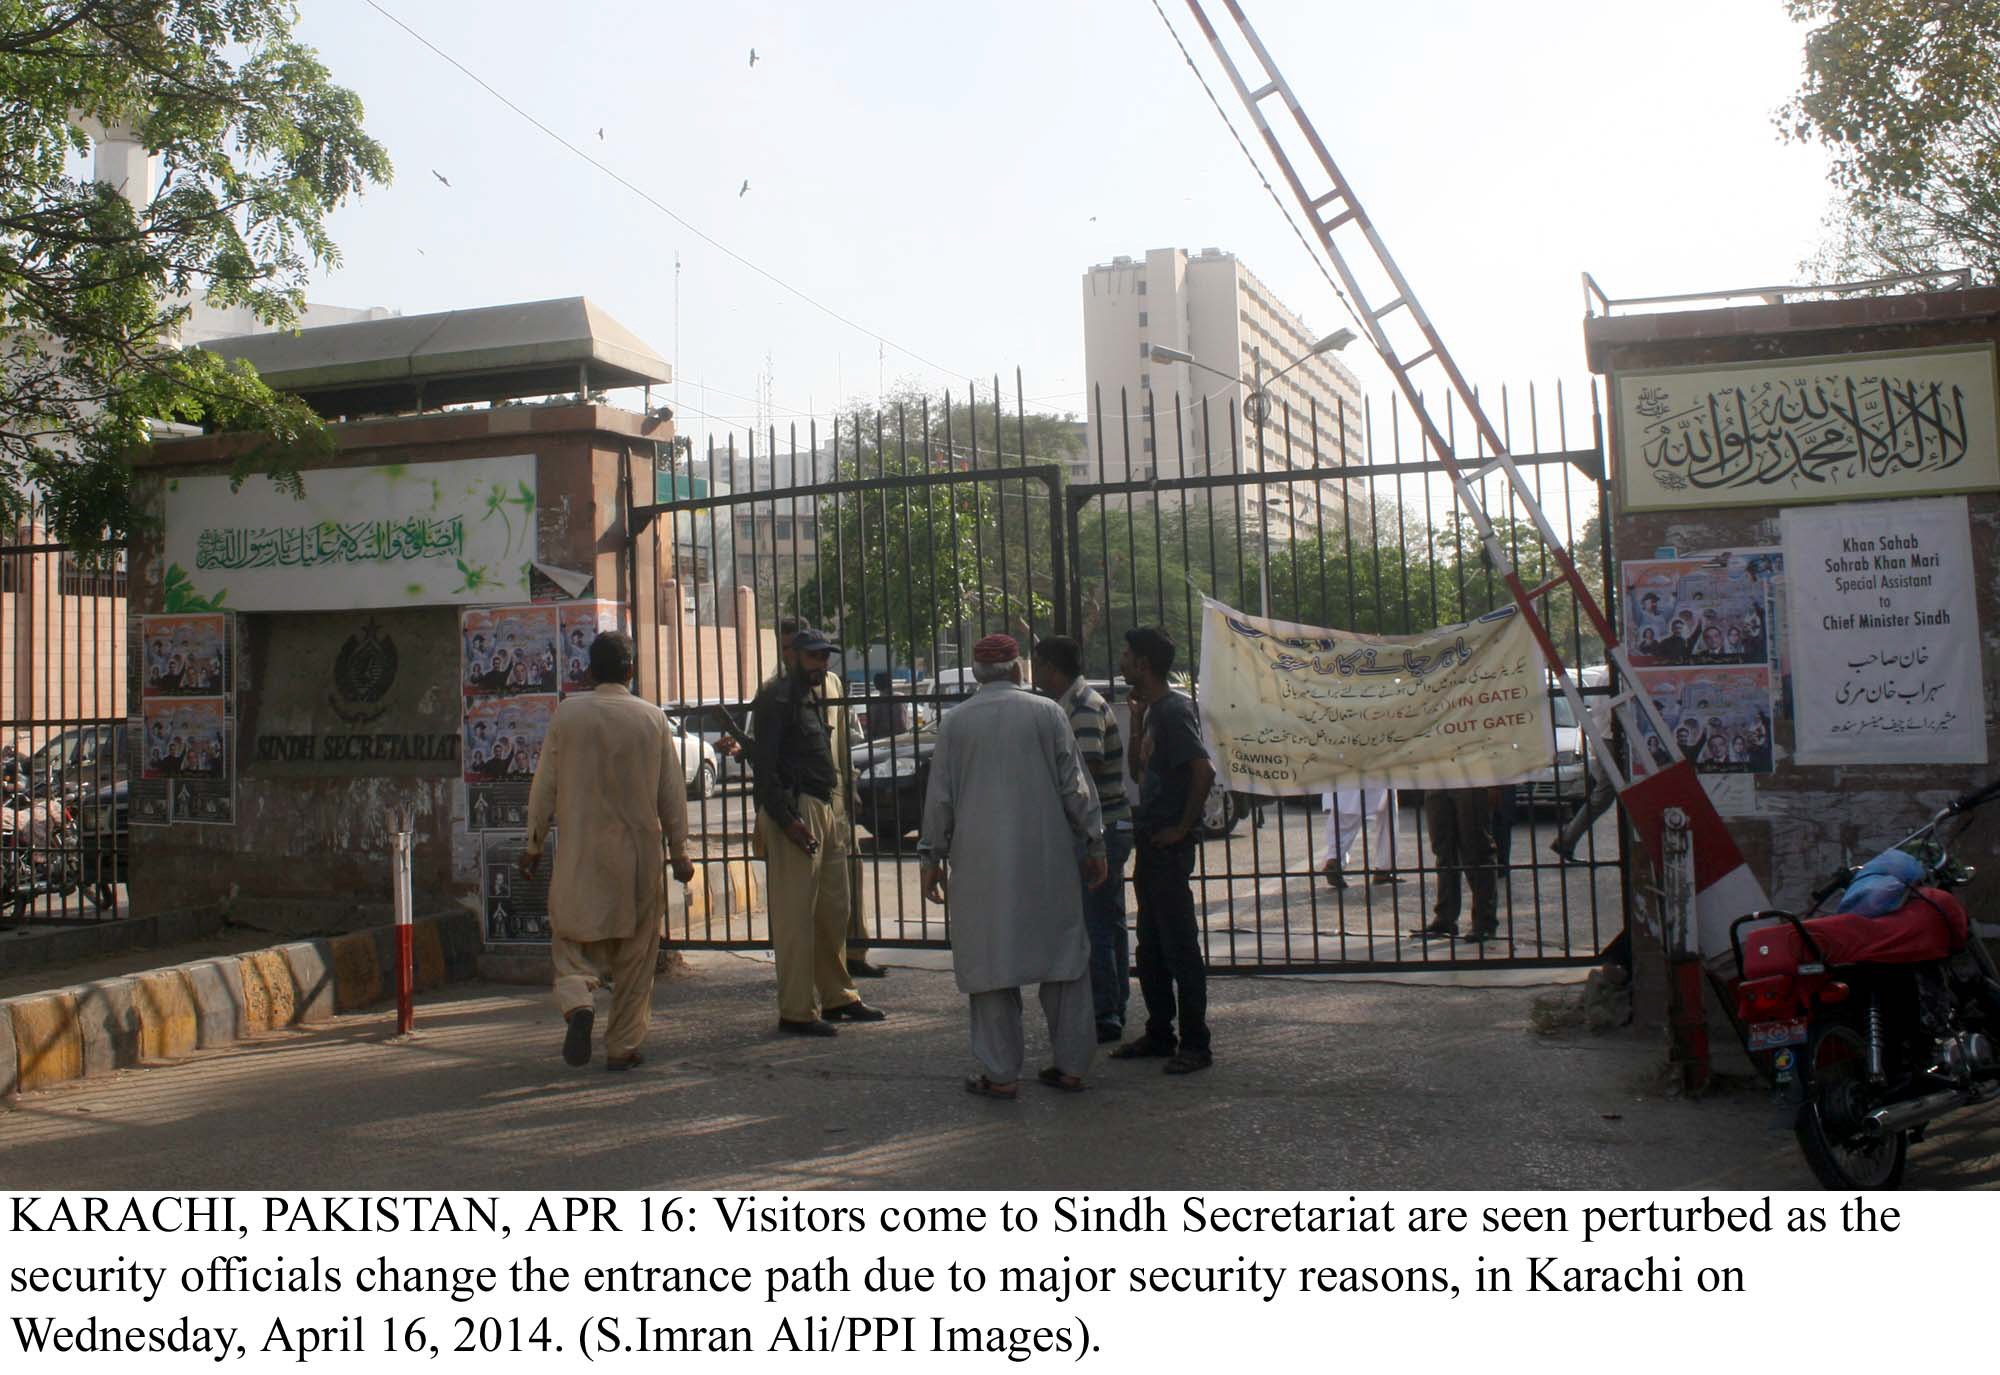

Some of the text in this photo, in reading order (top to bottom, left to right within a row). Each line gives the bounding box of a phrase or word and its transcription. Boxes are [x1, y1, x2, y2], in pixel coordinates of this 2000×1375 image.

[1843, 533, 1918, 552] Khan Sahab
[1825, 553, 1940, 573] Sohrab Khan Mari
[1836, 574, 1932, 594] Special Assistant
[1880, 597, 1891, 608] to
[1823, 609, 1950, 630] Chief Minister Sindh
[1848, 646, 1928, 673] خان صاحب
[1866, 680, 1896, 703] خان
[257, 735, 459, 761] SINDH SECRETARIAT
